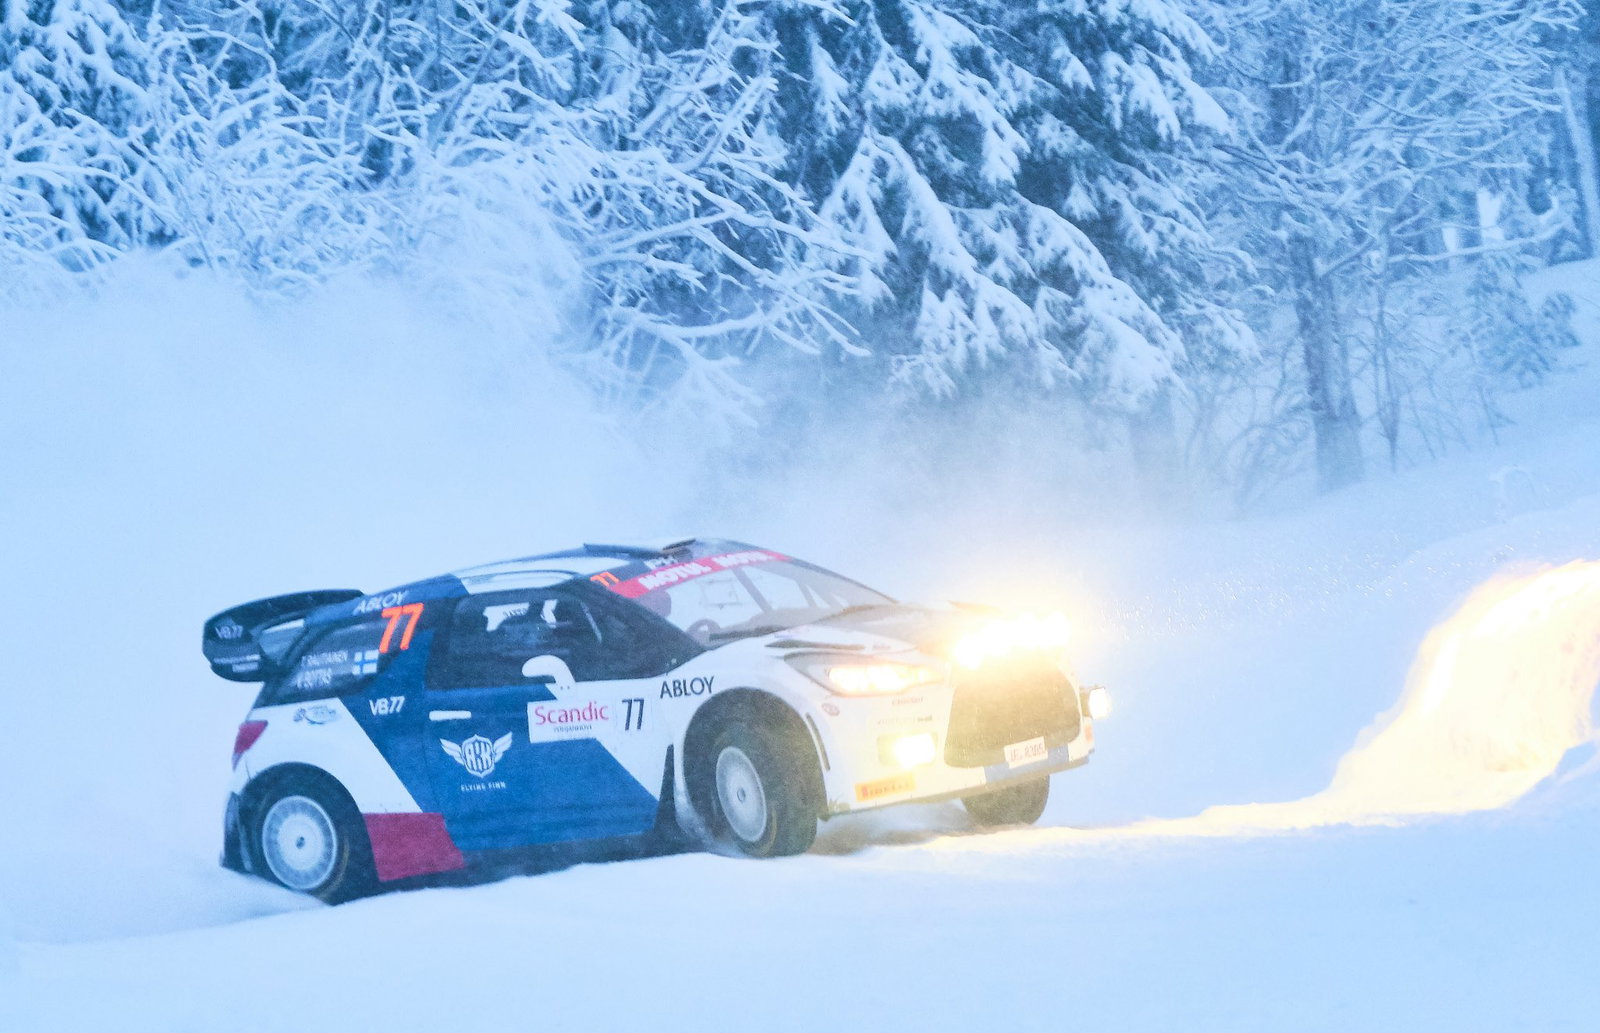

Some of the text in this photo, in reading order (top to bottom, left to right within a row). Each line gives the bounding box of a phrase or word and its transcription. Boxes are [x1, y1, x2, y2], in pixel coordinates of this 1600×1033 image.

[590, 571, 620, 587] 77
[638, 562, 712, 590] MOTUL
[352, 590, 409, 616] ABLOY
[379, 602, 425, 654] 77
[660, 675, 715, 699] ABLOY
[534, 701, 610, 726] Scandic
[622, 697, 645, 731] 77
[461, 781, 506, 792] FLYING FINN
